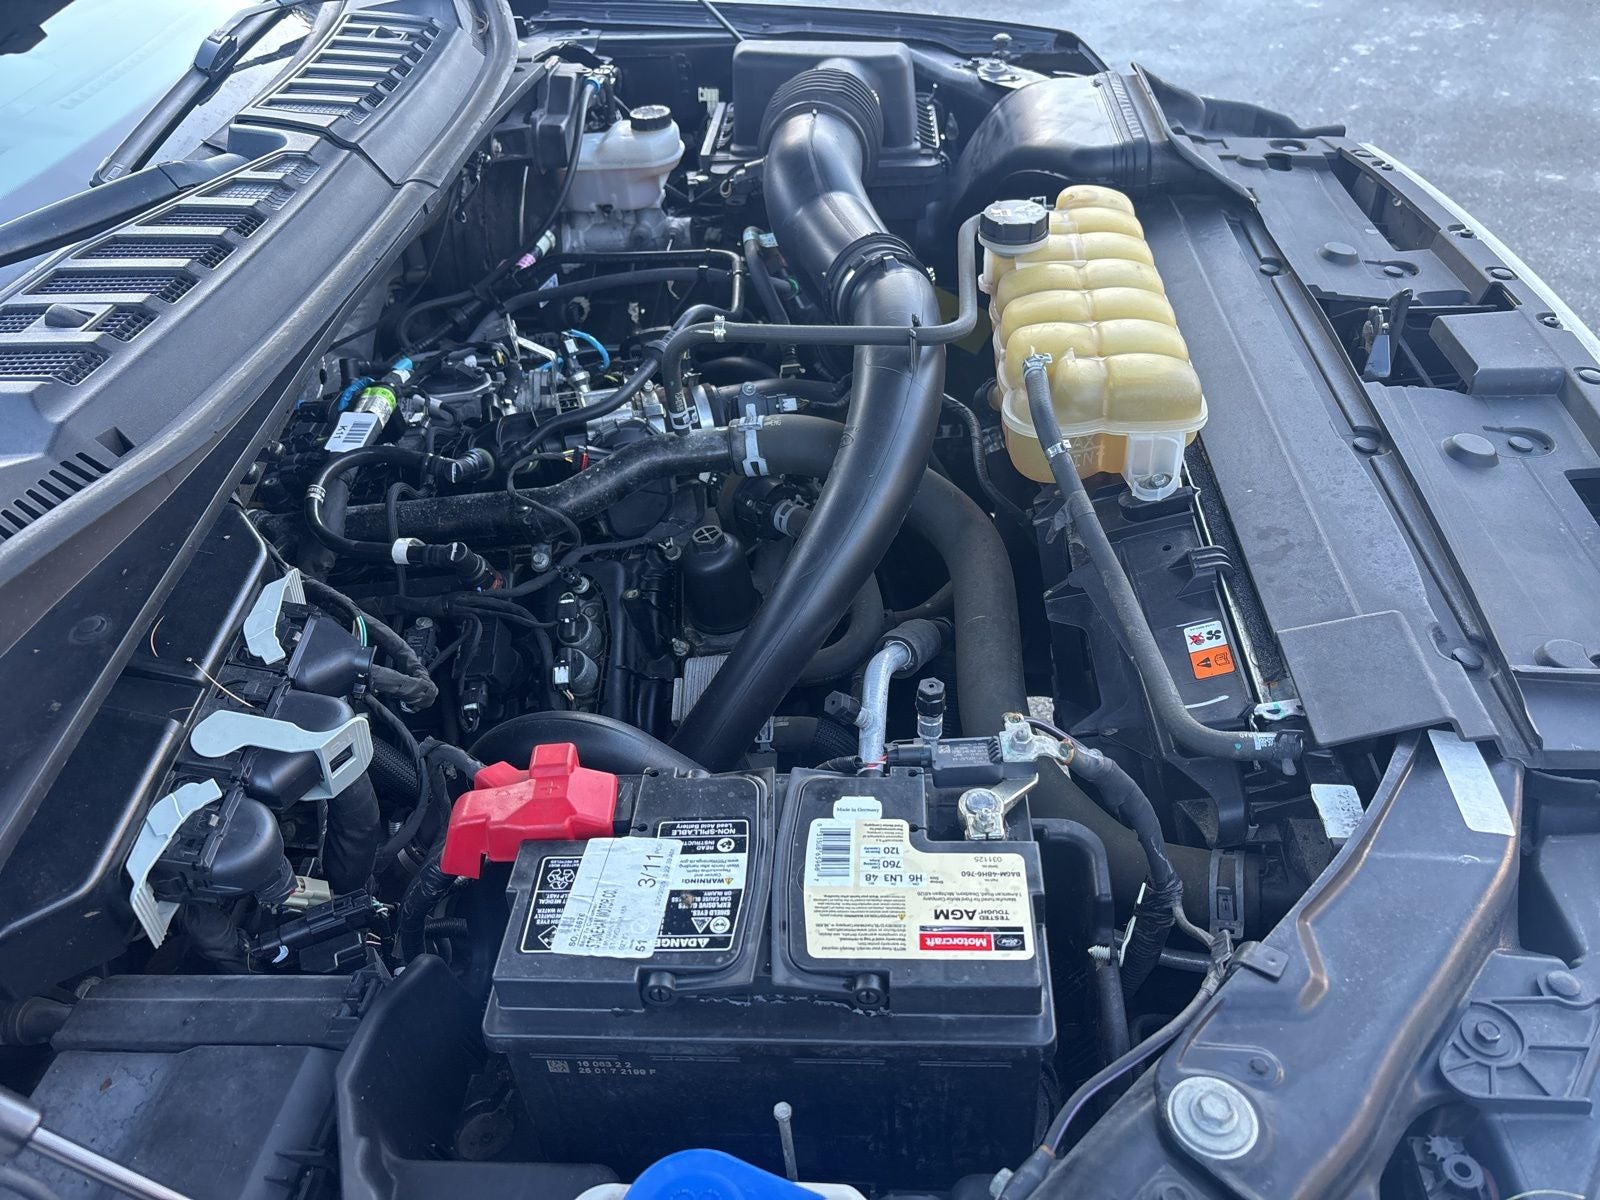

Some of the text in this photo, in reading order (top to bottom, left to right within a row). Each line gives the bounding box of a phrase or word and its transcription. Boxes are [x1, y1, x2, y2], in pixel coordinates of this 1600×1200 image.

[333, 426, 348, 438] K11
[671, 828, 736, 836] NON-SPILLABLE
[883, 847, 899, 855] 120
[882, 860, 901, 868] 760
[636, 855, 663, 888] 3/11
[865, 874, 922, 882] H6 LN3 48
[934, 909, 977, 920] AGM
[634, 941, 647, 952] 51
[654, 938, 697, 947] DANGE
[925, 937, 987, 947] Motorcraft
